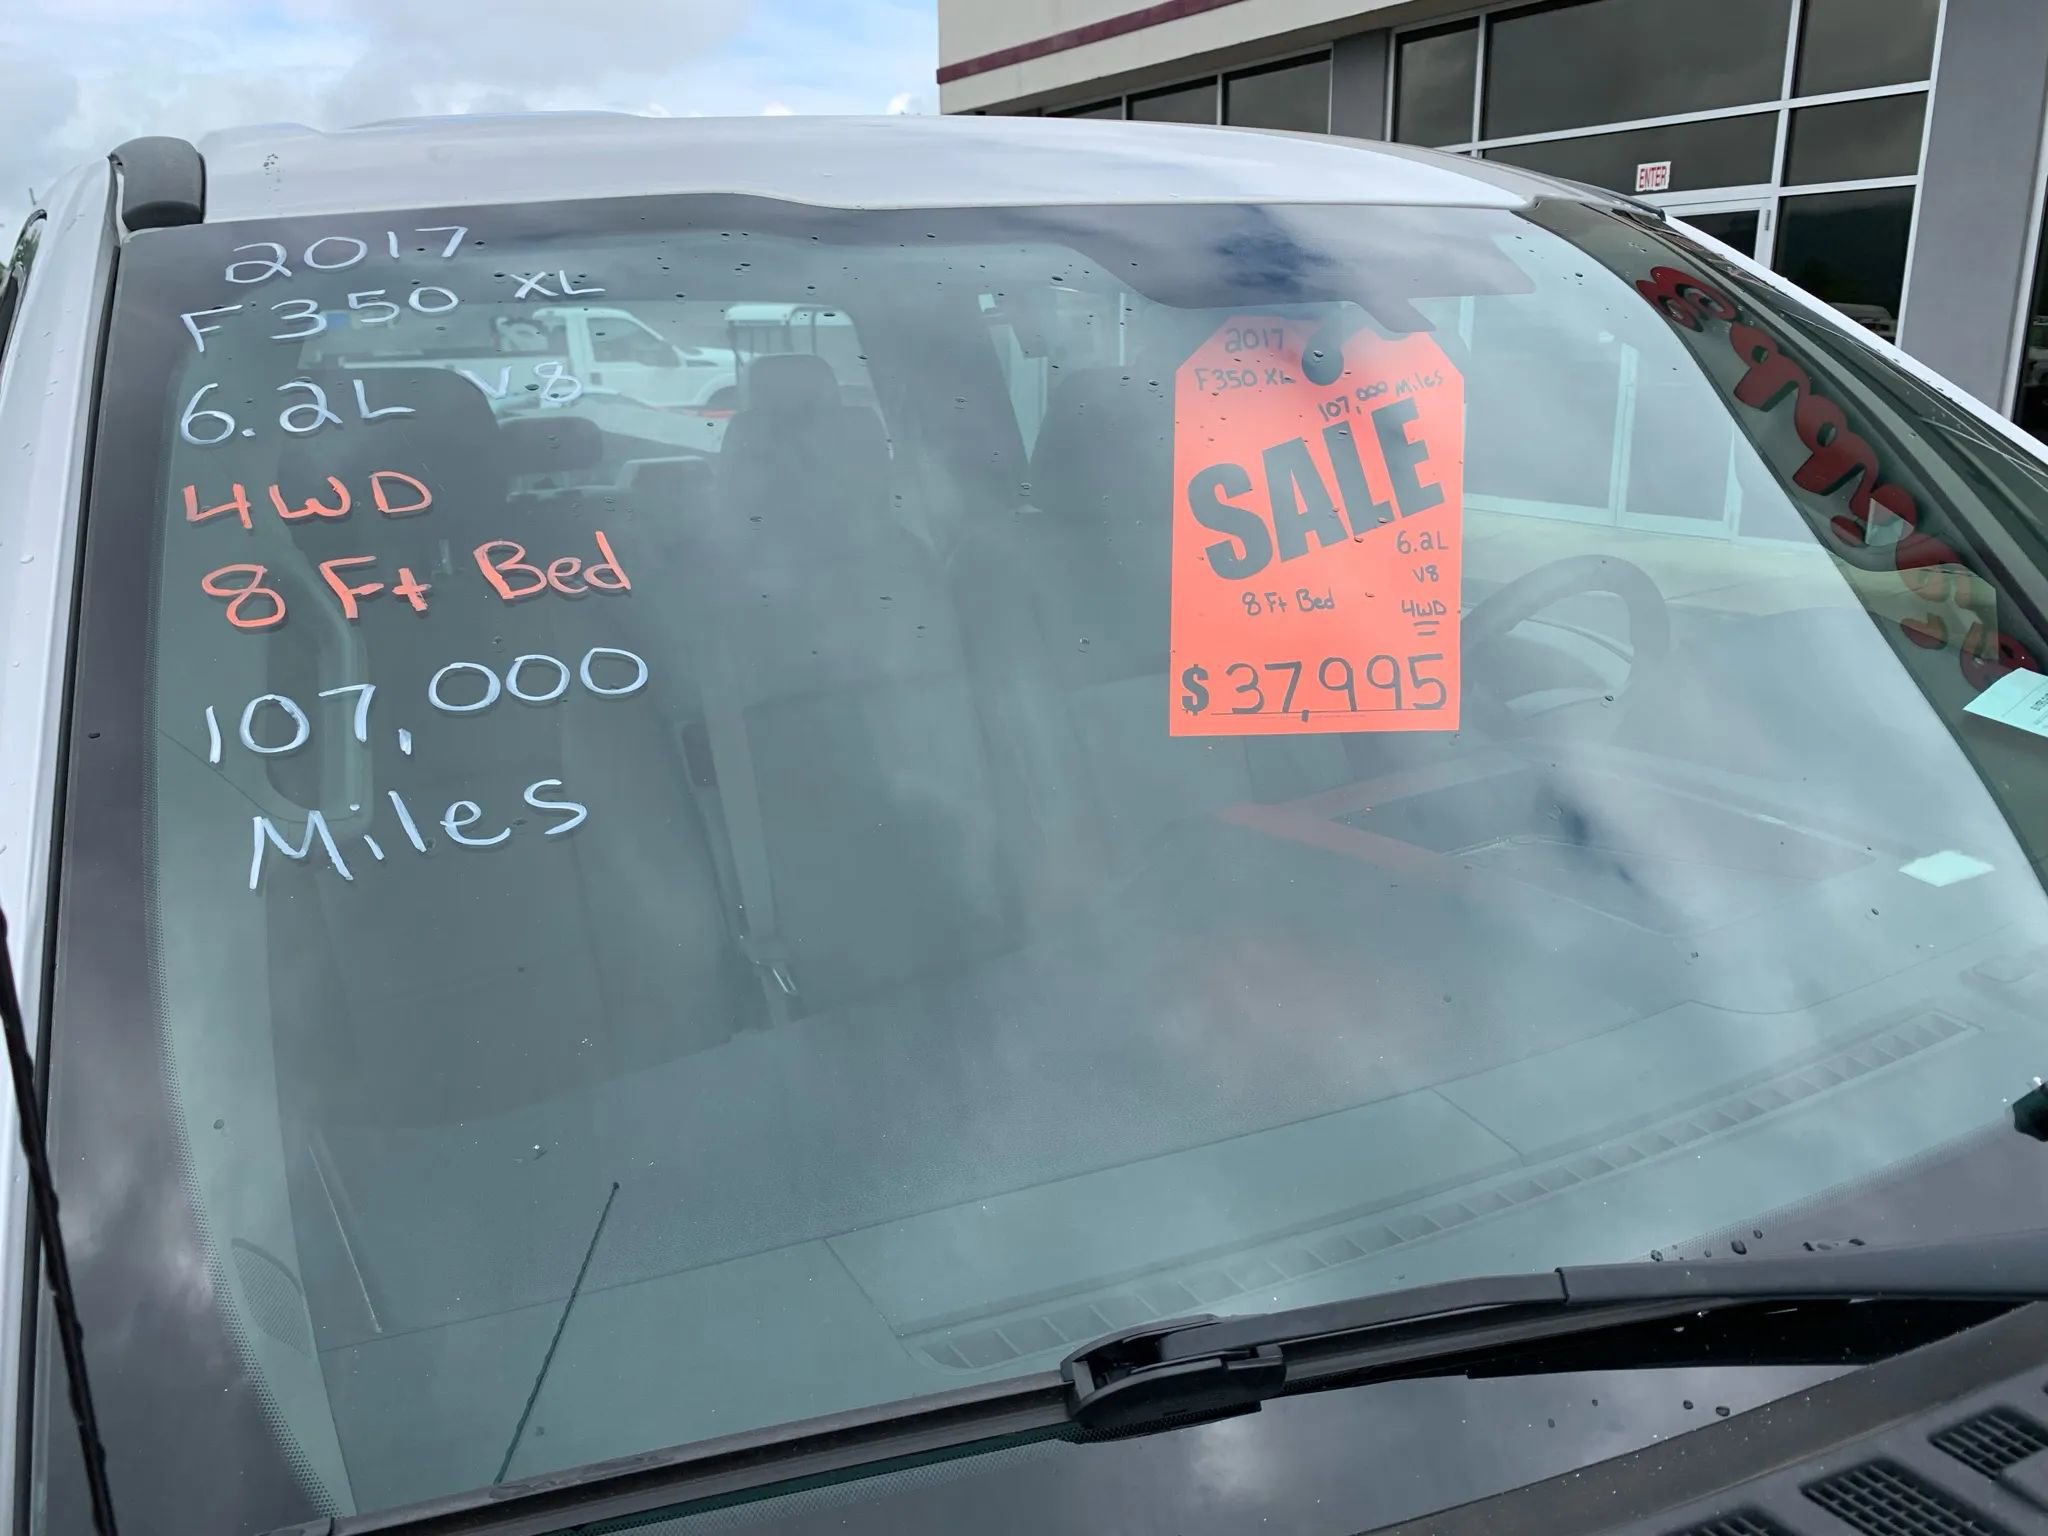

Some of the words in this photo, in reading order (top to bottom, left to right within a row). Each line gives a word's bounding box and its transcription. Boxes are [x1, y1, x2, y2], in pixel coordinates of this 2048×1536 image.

[1639, 166, 1666, 188] ENTER
[225, 226, 469, 284] 2017
[509, 269, 606, 299] XL
[1224, 327, 1285, 353] 2017
[1194, 368, 1258, 391] F350
[1265, 367, 1296, 386] XL
[1317, 381, 1388, 422] 107,000
[1395, 370, 1444, 397] Miles
[181, 378, 415, 445] 6.2L
[456, 361, 583, 403] V8
[183, 471, 433, 530] 4WD
[1187, 397, 1445, 580] SALE
[1396, 530, 1449, 555] 6.2L
[201, 563, 287, 628] 8
[319, 556, 432, 620] Ft
[473, 531, 632, 599] Bed
[1412, 564, 1440, 583] V8
[1241, 592, 1261, 616] 8
[1264, 591, 1287, 612] Ft
[1295, 588, 1335, 612] Bed
[1401, 598, 1447, 618] 4WD
[205, 647, 649, 764] 107,000
[249, 778, 589, 890] Miles
